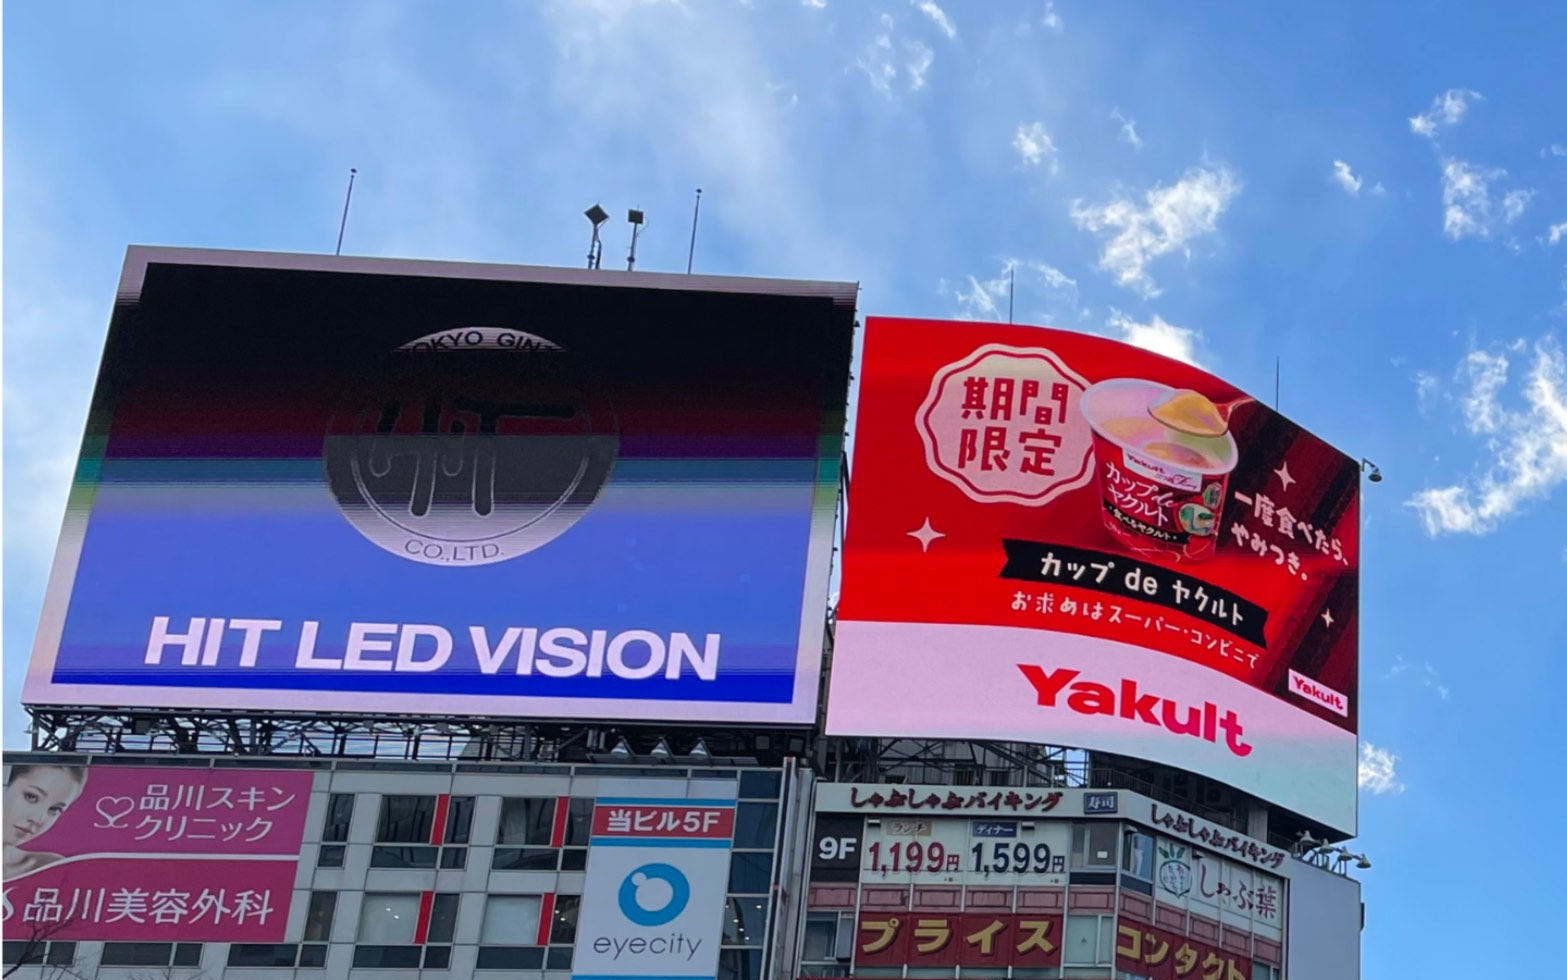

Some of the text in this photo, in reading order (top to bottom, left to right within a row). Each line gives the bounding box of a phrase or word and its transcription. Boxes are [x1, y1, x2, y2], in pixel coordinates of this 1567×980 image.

[961, 377, 1069, 425] 期間
[958, 426, 1062, 476] 限定
[1234, 490, 1349, 567] 一度食べたら、
[1231, 522, 1308, 582] やみつき。
[1041, 552, 1244, 627] カップ de ヤクルト
[144, 616, 721, 683] HIT LED VISION
[1017, 664, 1253, 758] Yakult
[1293, 675, 1344, 711] Yakult
[139, 784, 296, 812] 品川スキン
[851, 787, 1115, 812] しゃぶしゃぶバイキング 寿司
[134, 816, 274, 842] クリニック
[607, 809, 721, 834] 当ビル5F
[1151, 803, 1286, 869] しゃぶしゃぶバイキング
[818, 837, 857, 860] 9F
[22, 888, 274, 926] 品川美容外科
[593, 935, 703, 961] eyecity
[860, 918, 1057, 956] プライス
